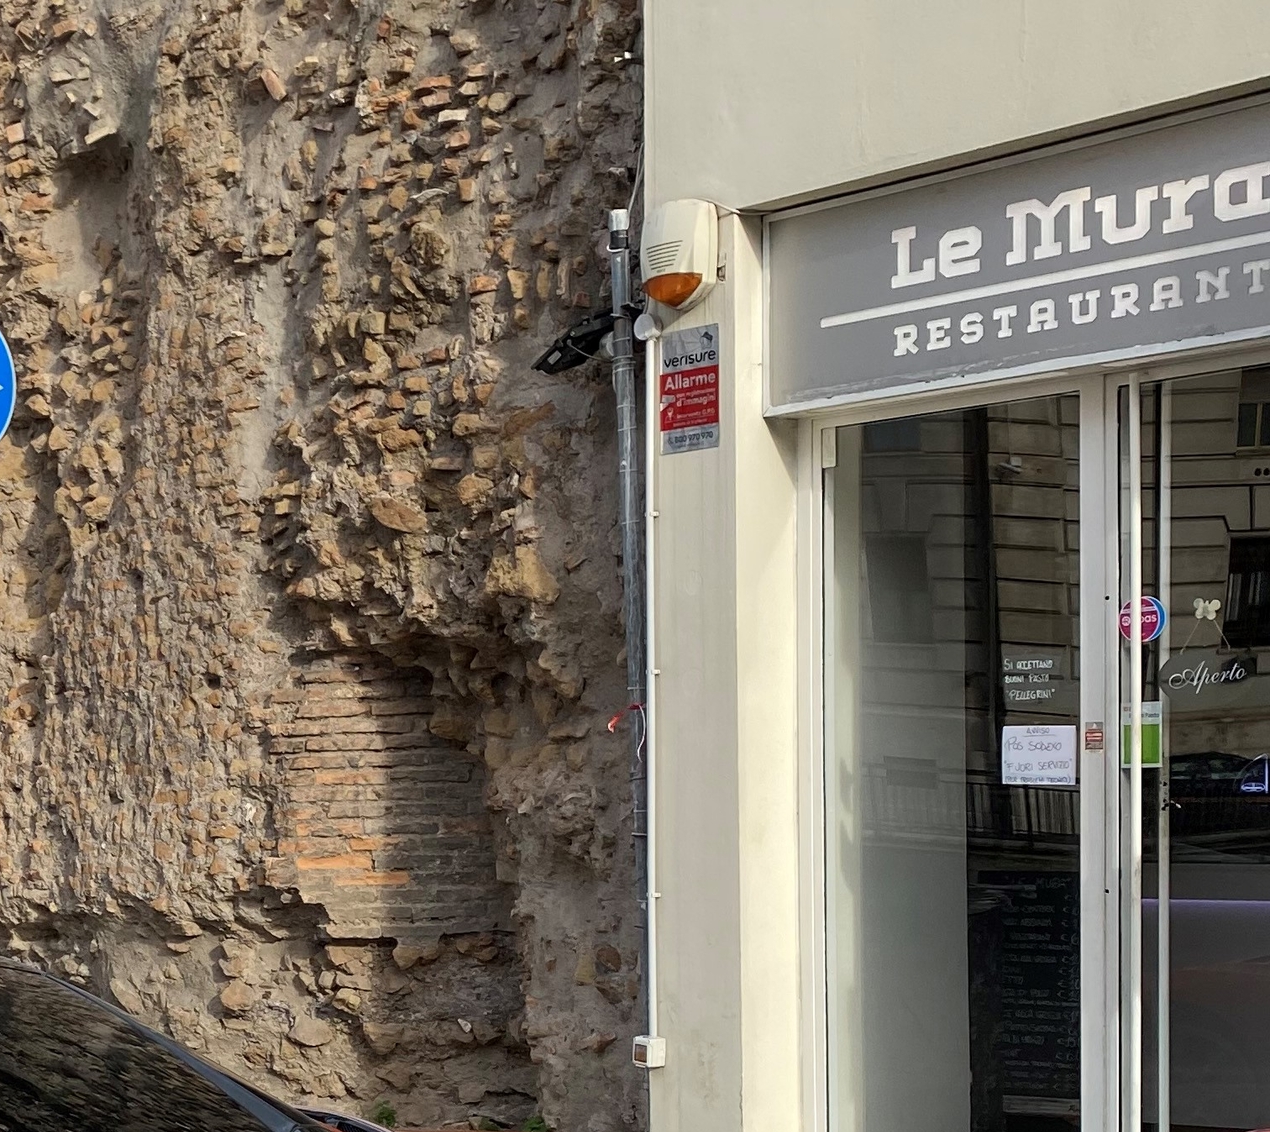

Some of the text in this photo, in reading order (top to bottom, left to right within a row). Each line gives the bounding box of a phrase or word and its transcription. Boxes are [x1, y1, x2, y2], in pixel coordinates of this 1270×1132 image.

[890, 224, 983, 290] Le
[893, 258, 1270, 357] RESTAURANT
[664, 350, 716, 368] verisure
[665, 373, 716, 391] Allarme
[1168, 660, 1247, 695] Aperto
